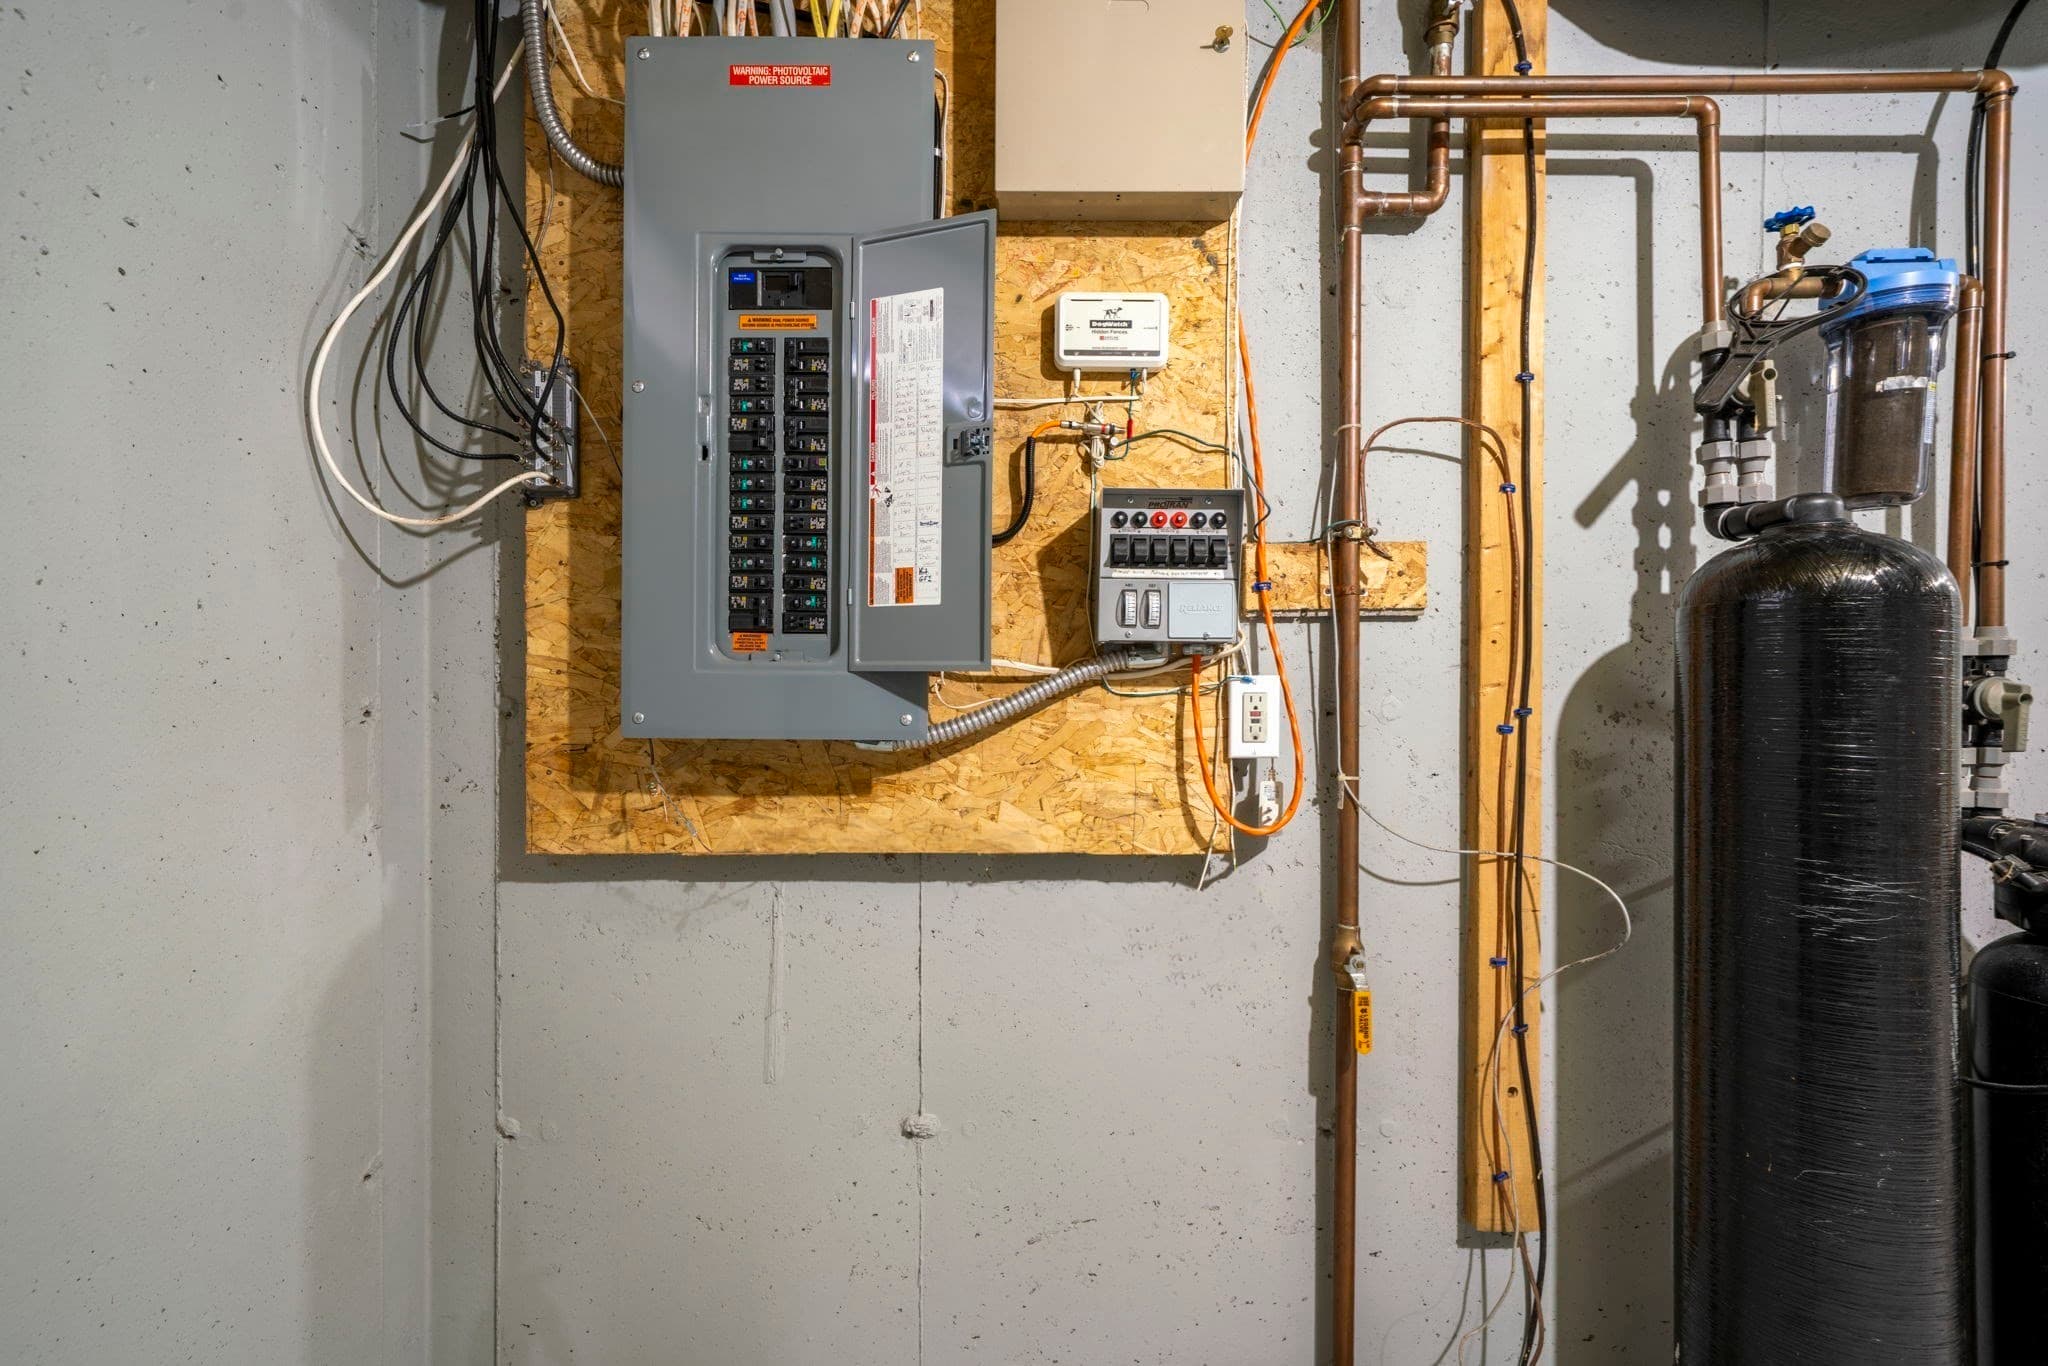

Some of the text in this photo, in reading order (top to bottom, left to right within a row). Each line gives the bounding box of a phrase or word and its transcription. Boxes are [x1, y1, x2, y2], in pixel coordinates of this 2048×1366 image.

[733, 66, 828, 75] WARNING: PHOTOVOLTAIC
[749, 76, 812, 85] POWER SOURCE
